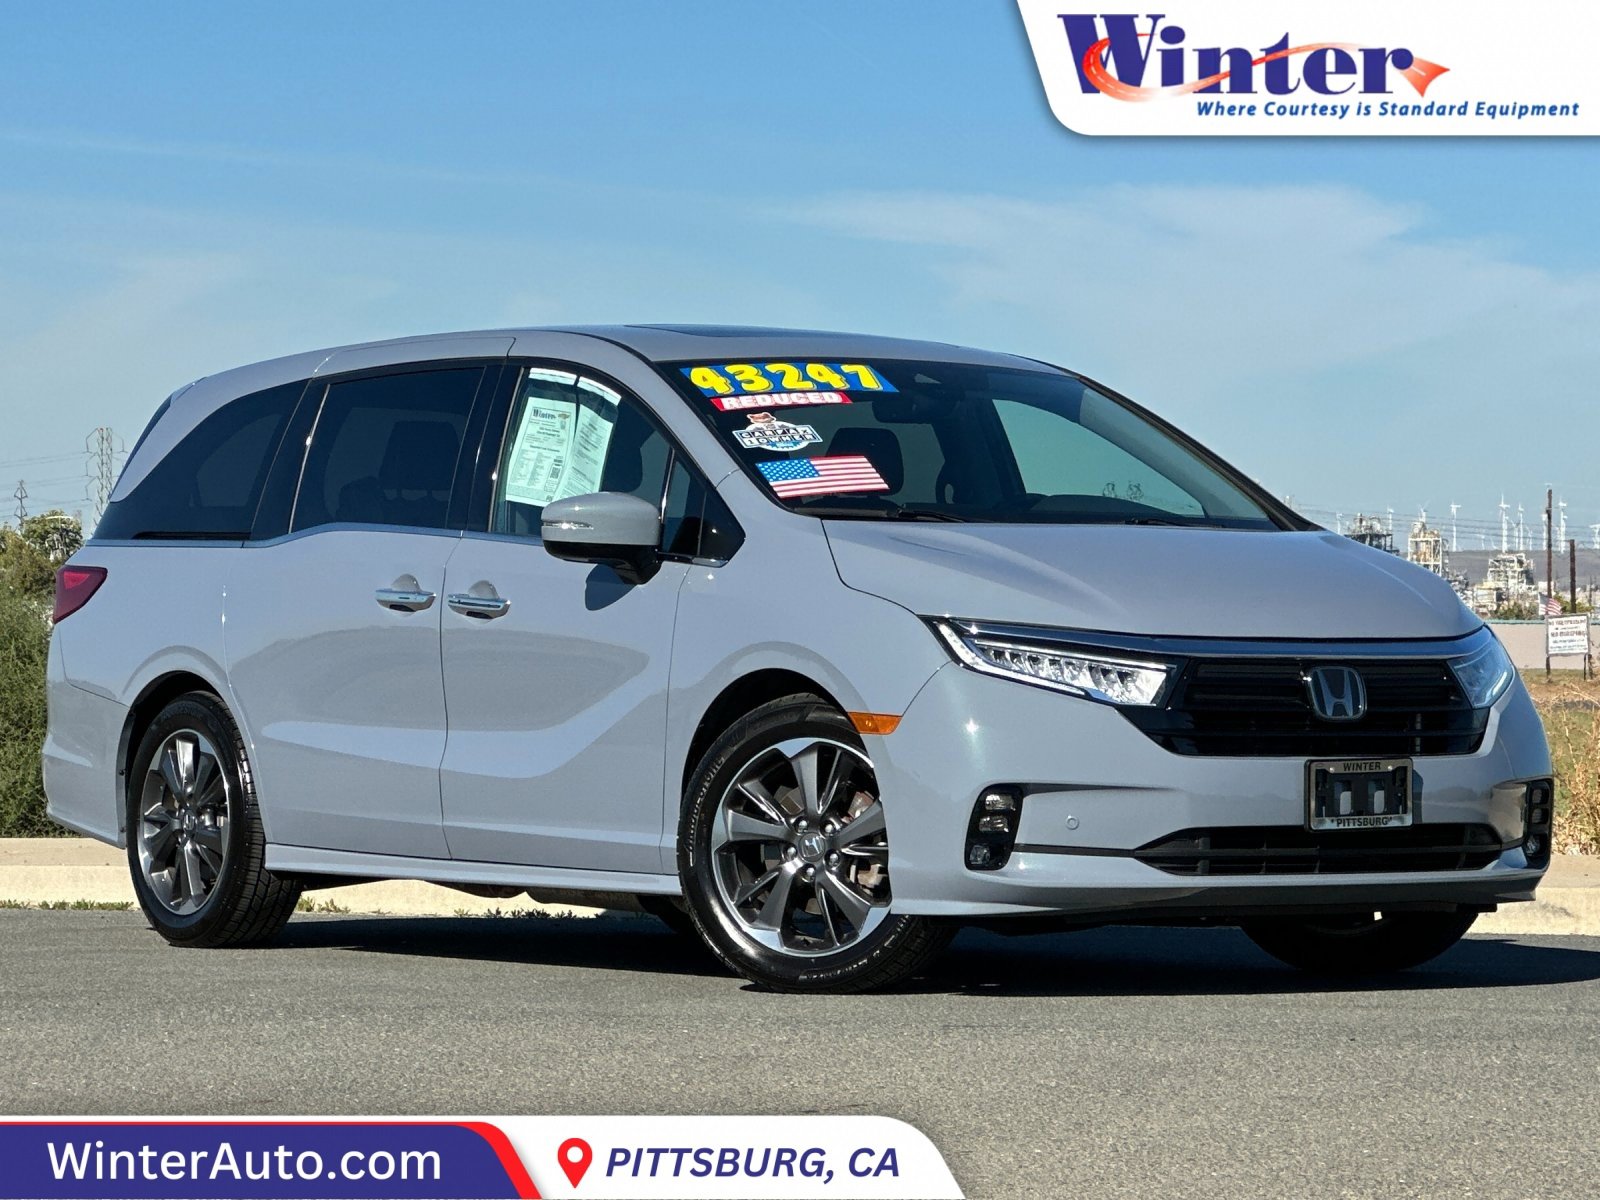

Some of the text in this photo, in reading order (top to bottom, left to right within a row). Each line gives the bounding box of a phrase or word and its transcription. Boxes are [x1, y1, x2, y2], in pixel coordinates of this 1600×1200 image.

[690, 363, 880, 394] 43247
[722, 391, 843, 410] REDUCED
[740, 427, 809, 438] CARFAX
[757, 433, 814, 444] OWNER
[1343, 761, 1382, 771] WINTER
[1336, 817, 1389, 827] PITTSBURG
